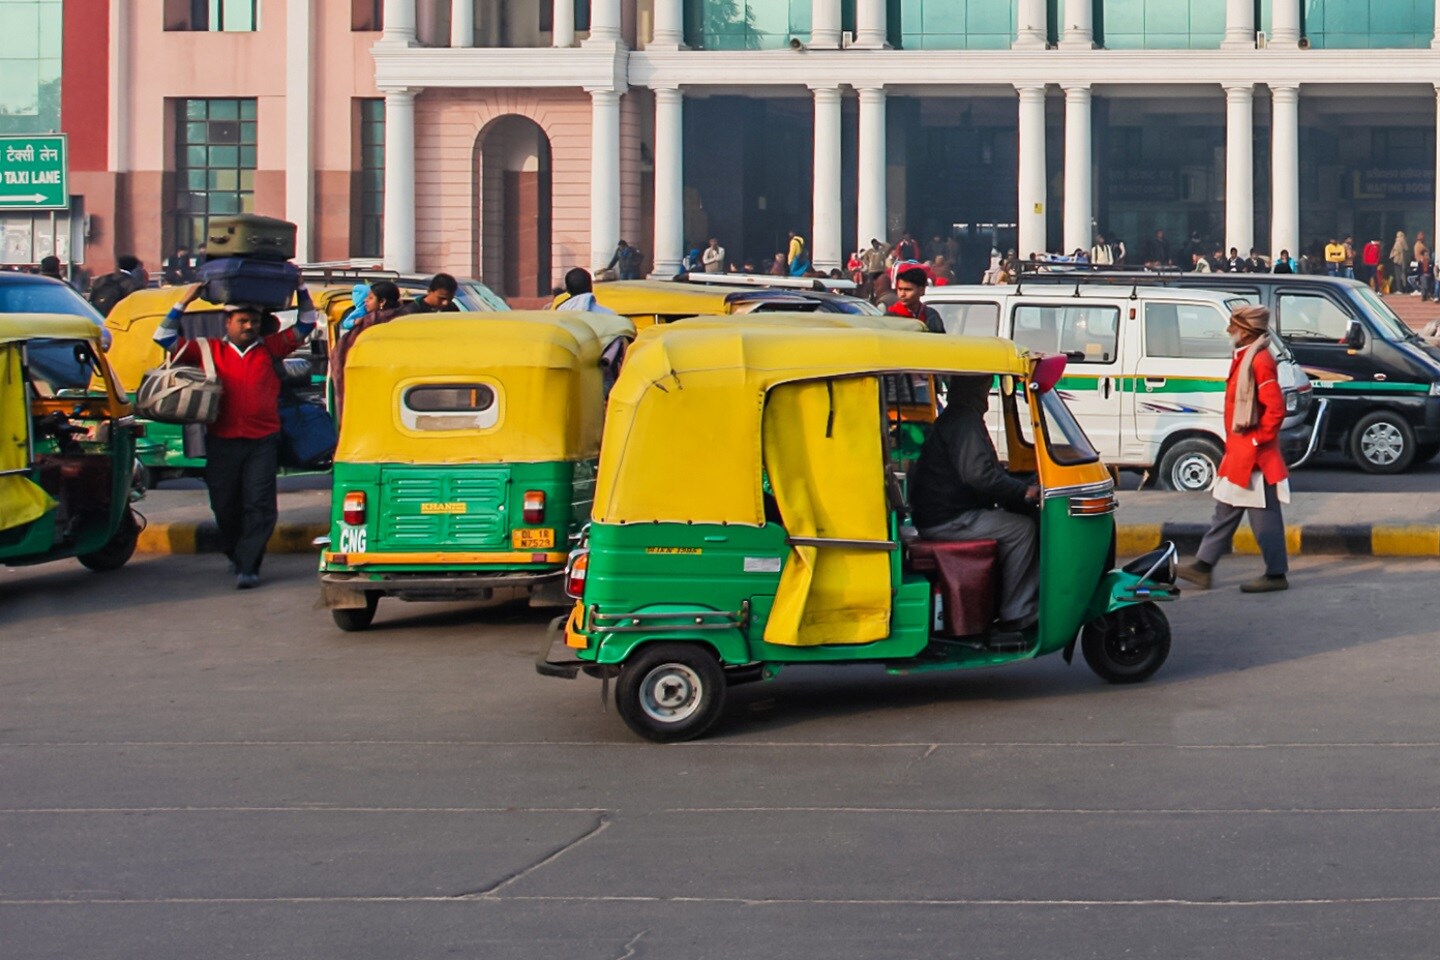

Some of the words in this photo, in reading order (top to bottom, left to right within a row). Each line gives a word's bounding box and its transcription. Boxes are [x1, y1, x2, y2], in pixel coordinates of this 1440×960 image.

[6, 144, 34, 162] टैक्सी
[39, 145, 58, 162] लेन
[4, 171, 29, 184] TAXI
[31, 171, 61, 184] LANE
[421, 503, 452, 511] KHAN
[340, 528, 367, 552] CNG
